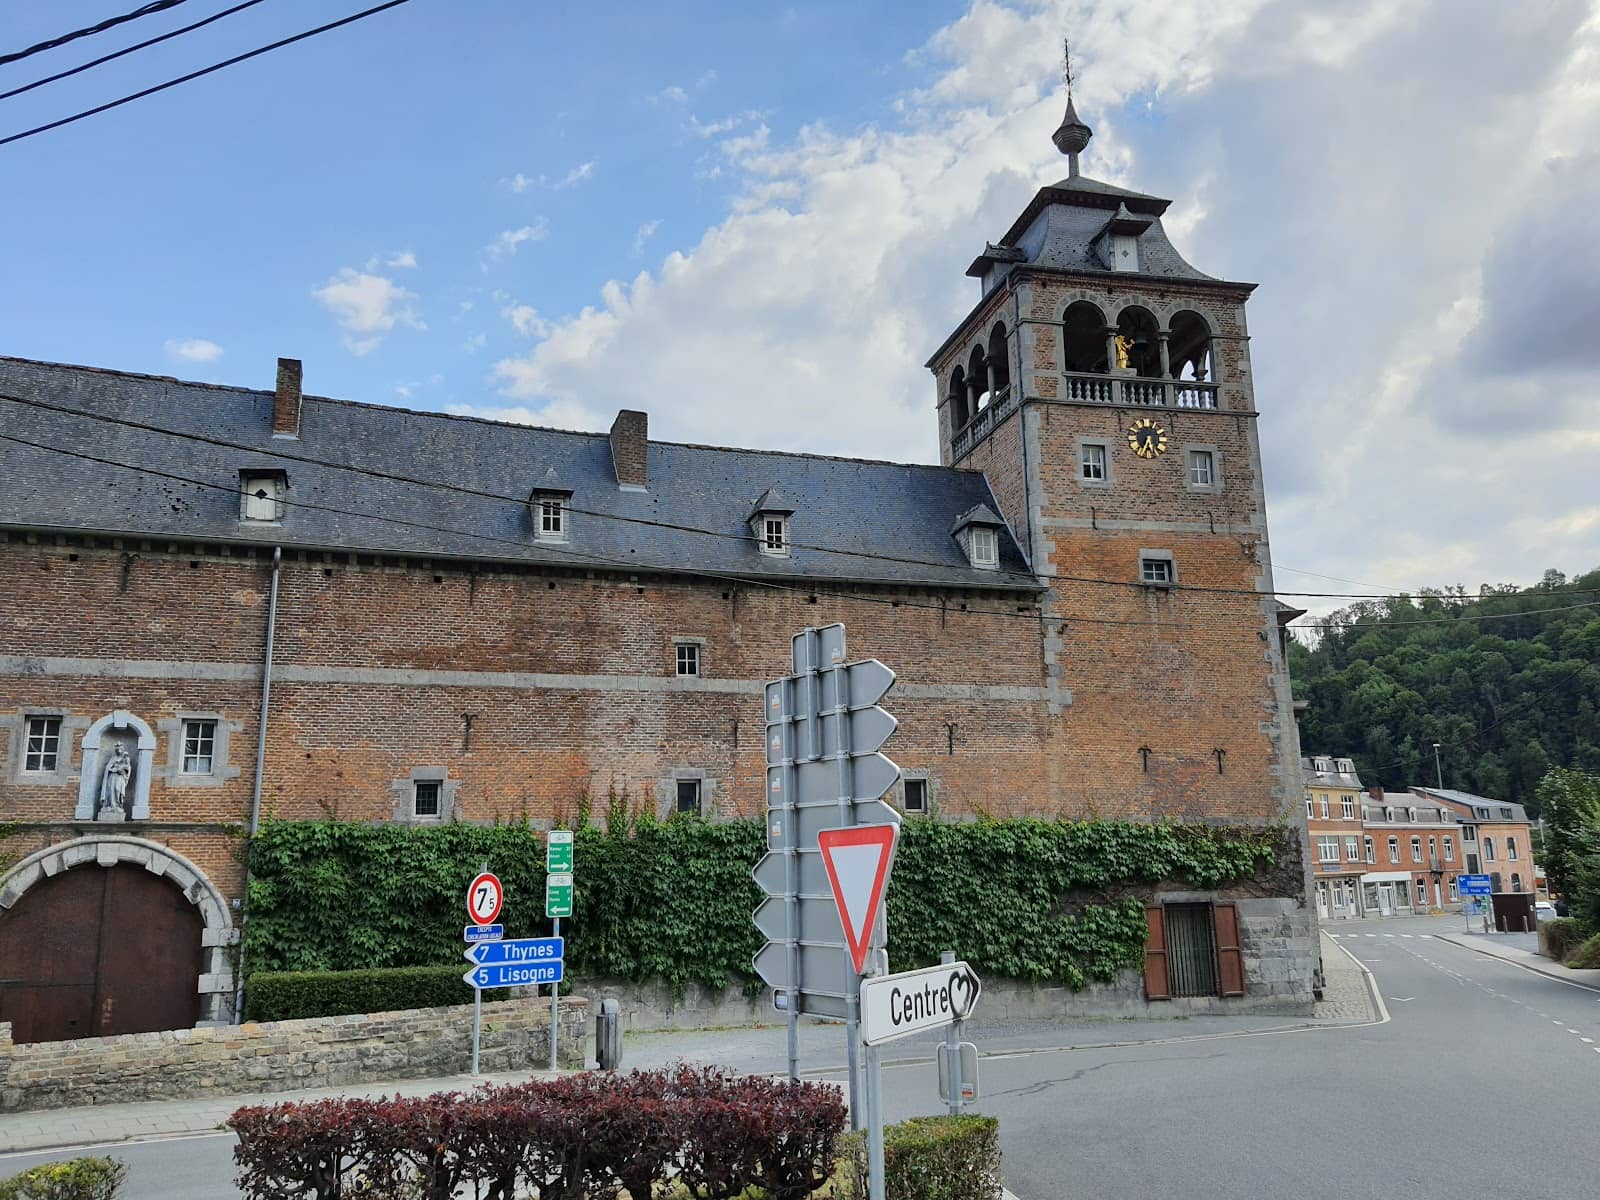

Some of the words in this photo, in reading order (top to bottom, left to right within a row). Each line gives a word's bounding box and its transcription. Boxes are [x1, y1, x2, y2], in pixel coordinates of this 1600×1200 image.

[479, 945, 490, 961] 7
[502, 943, 554, 962] Thynes
[479, 968, 489, 985] 5
[499, 967, 555, 984] Lisogne
[890, 981, 949, 1026] Centre
